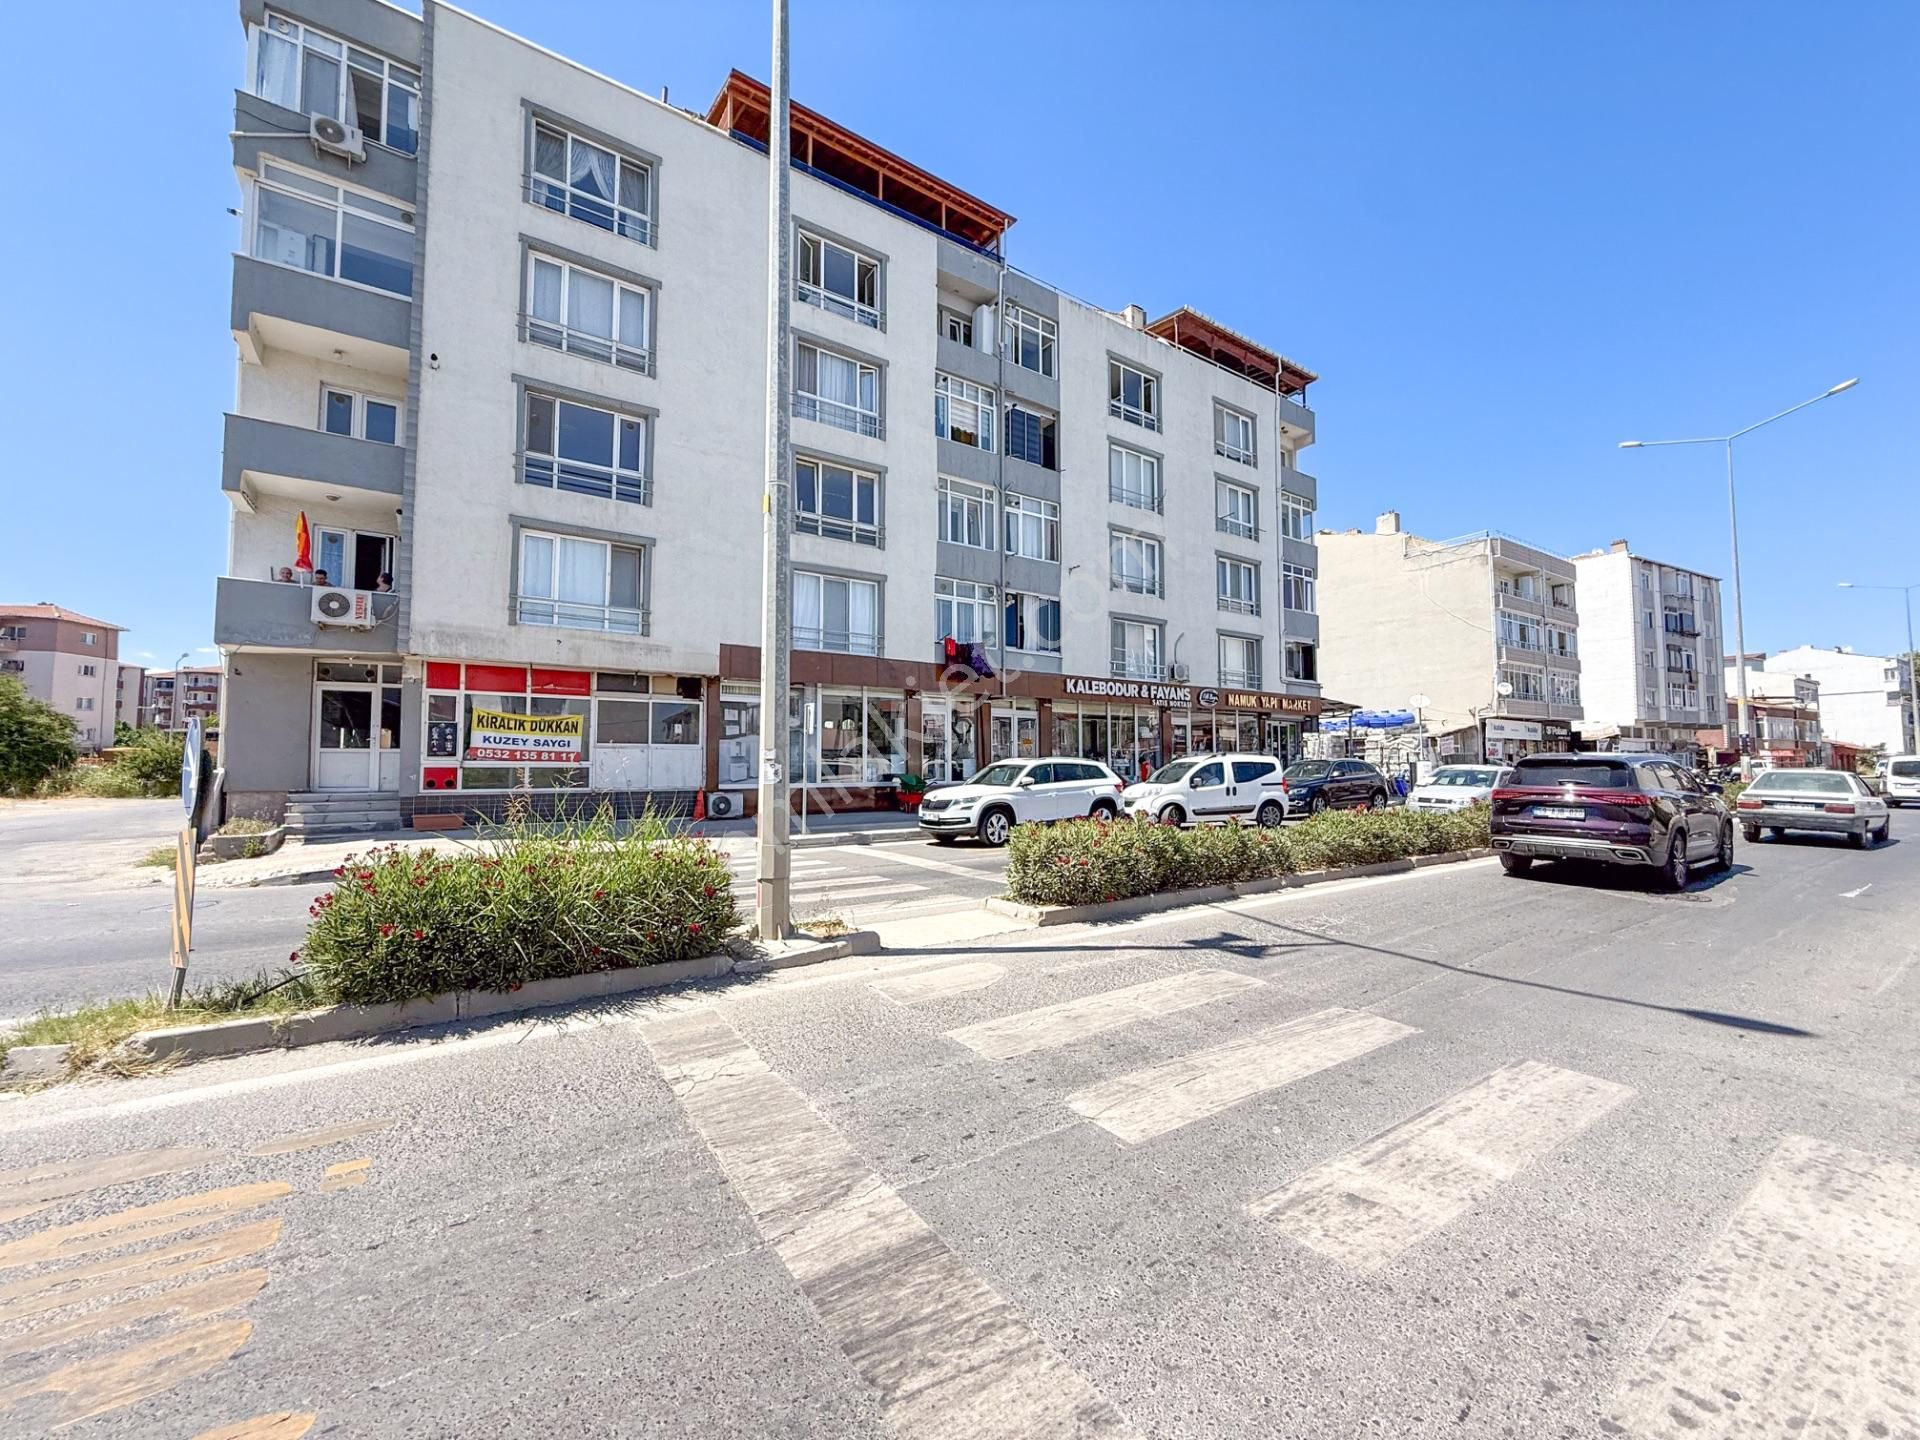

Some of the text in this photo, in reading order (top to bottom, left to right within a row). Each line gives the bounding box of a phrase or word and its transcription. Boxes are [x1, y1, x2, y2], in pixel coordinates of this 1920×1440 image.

[1065, 678, 1139, 698] KALEBODUR
[1140, 686, 1149, 698] &
[1150, 686, 1191, 700] FAYANS
[1227, 693, 1257, 707] NAMUK
[1260, 696, 1278, 709] YAPI
[1282, 698, 1311, 712] MARKET
[476, 712, 579, 734] KİRALIK DÜKKAN
[482, 735, 571, 748] KUZEY SAYGI
[477, 749, 510, 759] 0532
[514, 751, 537, 760] 135
[541, 752, 555, 760] 81
